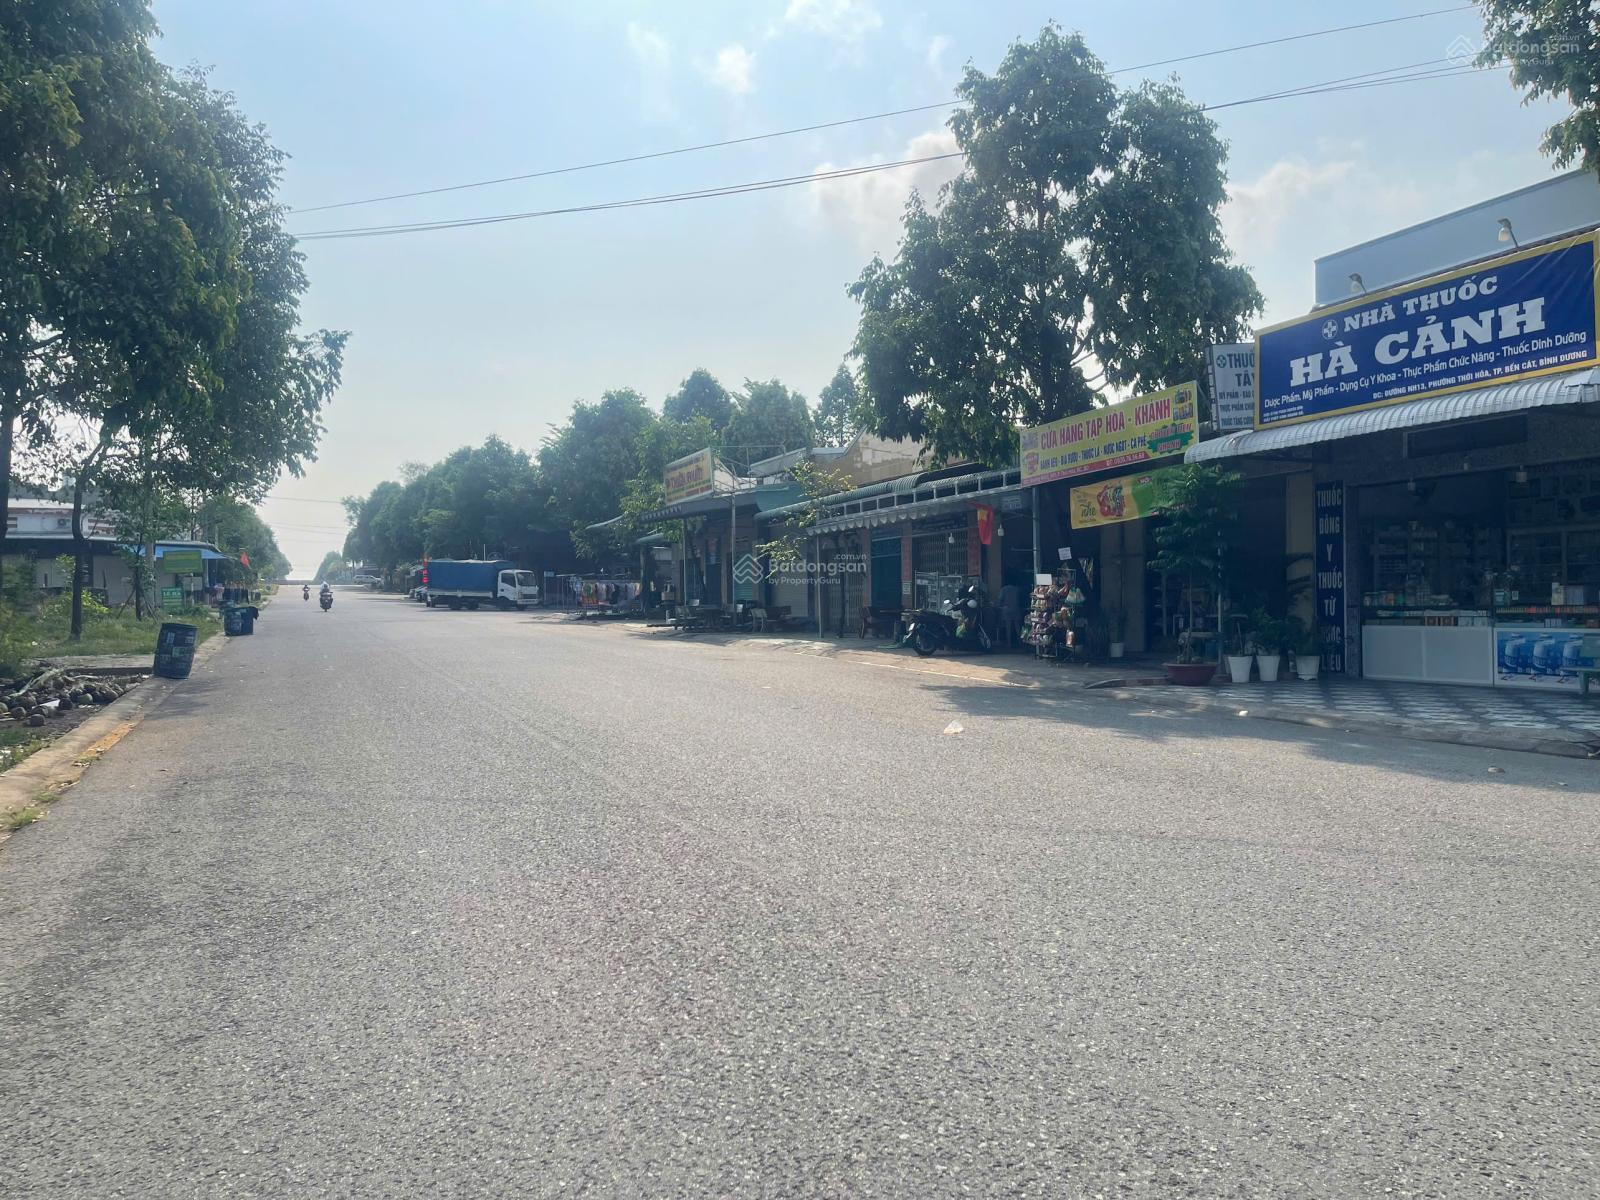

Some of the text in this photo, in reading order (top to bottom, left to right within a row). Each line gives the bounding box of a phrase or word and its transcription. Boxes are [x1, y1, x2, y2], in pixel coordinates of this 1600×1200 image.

[1343, 276, 1498, 332] NHÀ THUỐC
[1290, 296, 1546, 387] HÀ CẢNH
[1264, 398, 1280, 410] Dược
[1302, 389, 1313, 401] Mỹ
[1314, 384, 1334, 397] Phẩm
[1340, 380, 1358, 392] Dụng
[1360, 378, 1369, 389] Cụ
[1371, 374, 1376, 385] Y
[1377, 370, 1396, 384] Khoa
[1402, 366, 1422, 378] Thực
[1424, 360, 1447, 374] Phẩm
[1449, 355, 1469, 368] Chức
[1472, 352, 1495, 364] Năng
[1502, 341, 1529, 357] Thuốc
[1532, 338, 1552, 351] Dinh
[1555, 332, 1586, 346] Dưỡng
[1493, 367, 1503, 375] TP.
[1504, 362, 1520, 373] BẾN
[1539, 355, 1558, 366] BÌNH
[1560, 350, 1588, 362] DƯƠNG
[1235, 370, 1254, 387] TÂ
[1041, 426, 1057, 450] CỬA
[1060, 422, 1084, 445] HÀNG
[1086, 417, 1103, 441] TẠP
[1135, 399, 1171, 426] KHÁNH
[1317, 482, 1342, 507] THUỐC
[1319, 514, 1340, 534] ĐÔNG
[1326, 544, 1332, 562] Y
[1318, 566, 1342, 589] THUỐC
